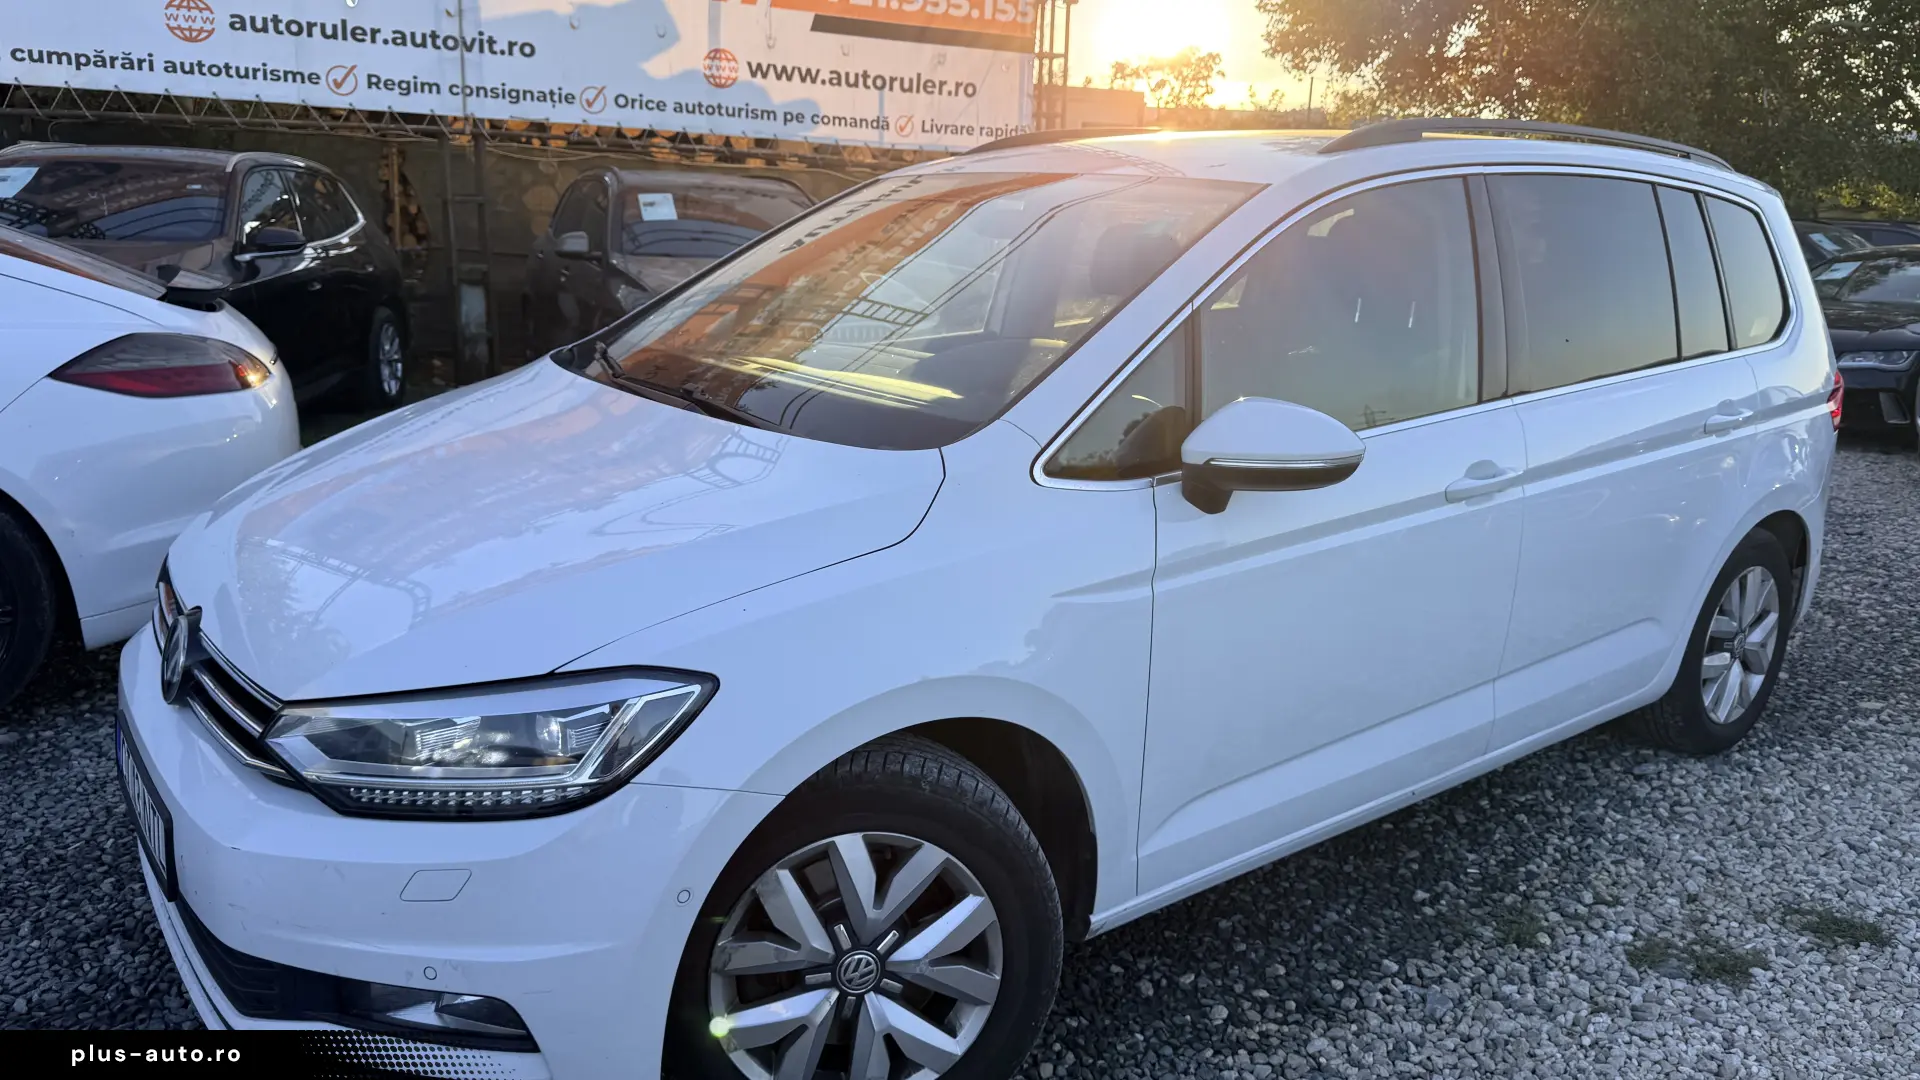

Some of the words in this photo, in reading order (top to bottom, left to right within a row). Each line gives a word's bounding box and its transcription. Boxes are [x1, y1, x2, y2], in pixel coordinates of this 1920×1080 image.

[229, 13, 536, 58] autoruler.autovit.ro
[10, 47, 154, 71] cumpărări
[163, 59, 321, 85] autoturisme
[746, 60, 977, 98] www.autoruler.ro
[366, 73, 440, 96] Regim
[448, 82, 576, 108] consignație
[614, 93, 667, 112] Orice
[673, 101, 777, 122] autoturism
[783, 108, 805, 125] pe
[811, 111, 890, 131] comandă
[921, 119, 975, 136] Livrare
